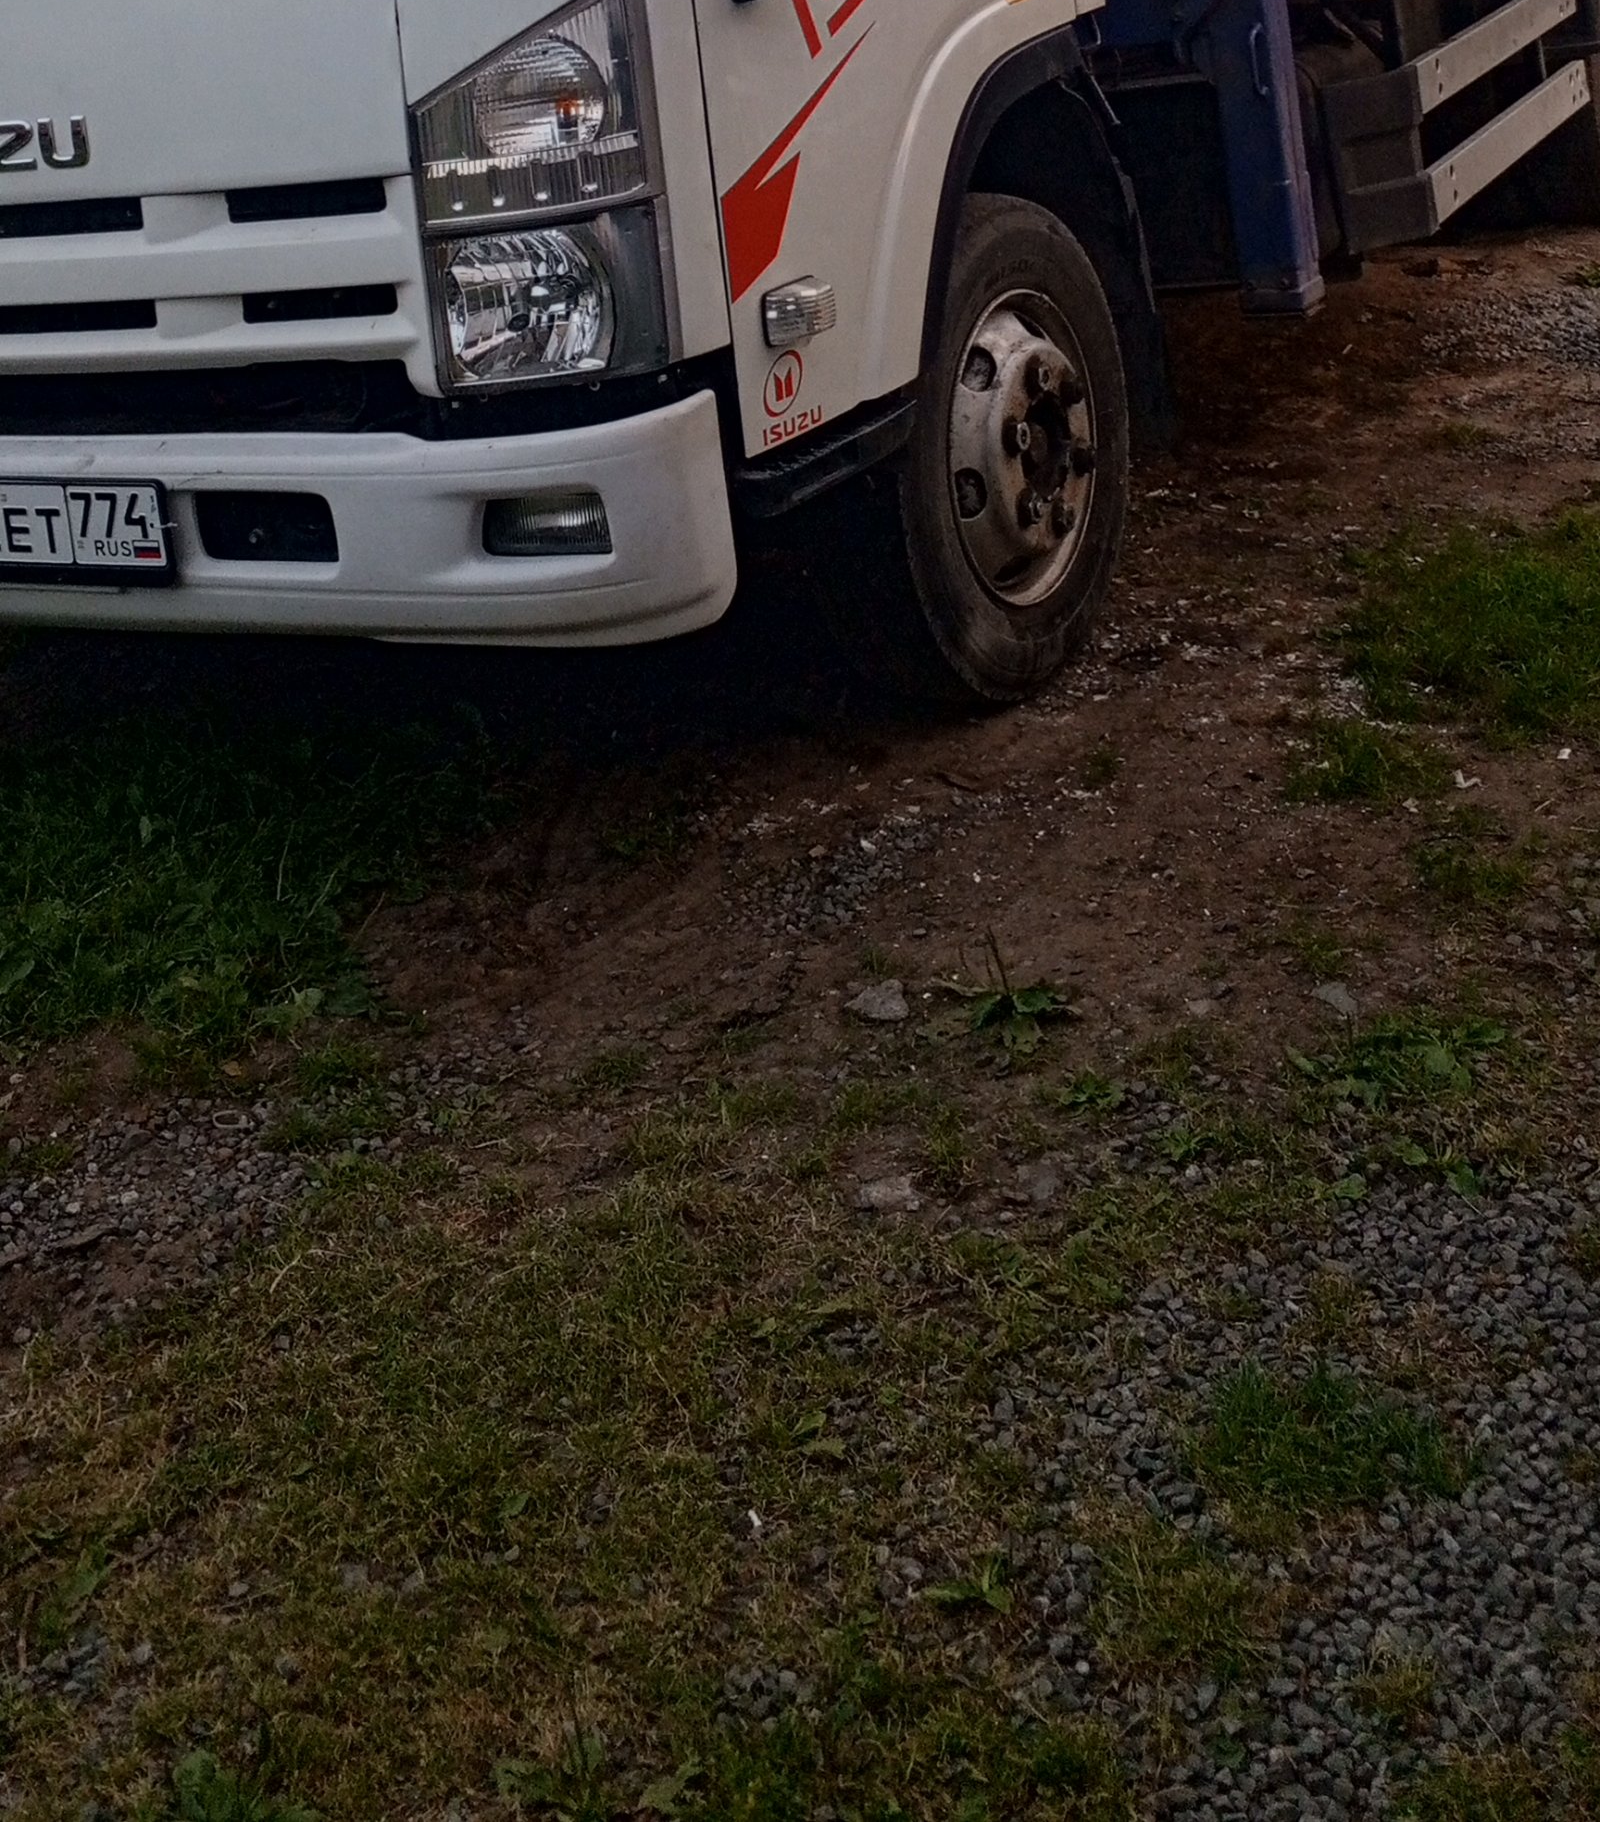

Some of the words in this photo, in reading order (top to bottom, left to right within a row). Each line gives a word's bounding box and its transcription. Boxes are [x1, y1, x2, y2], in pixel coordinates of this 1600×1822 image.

[762, 405, 822, 446] ISUZU
[69, 492, 149, 539] 774
[94, 540, 132, 557] RUS
